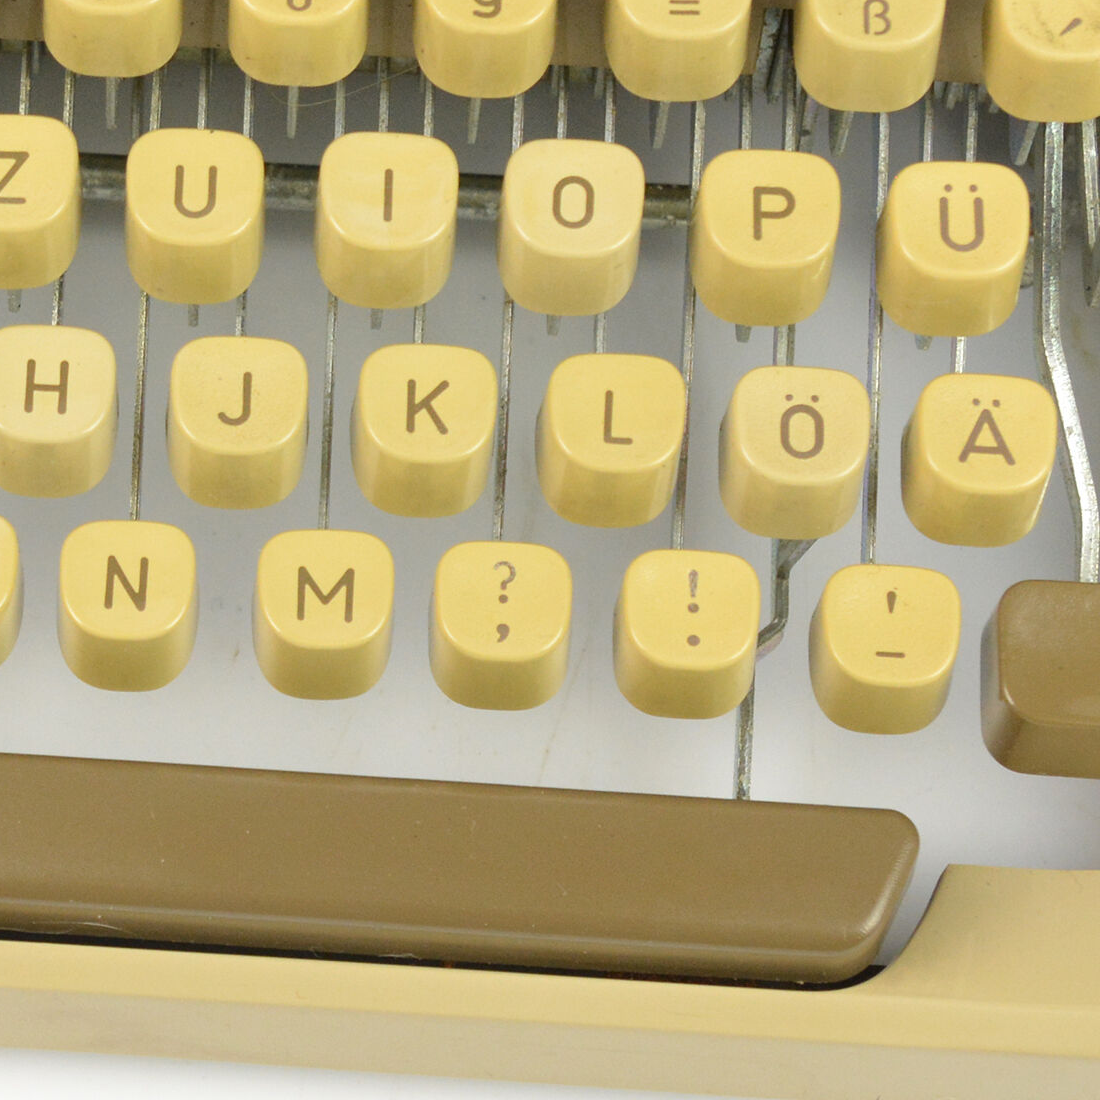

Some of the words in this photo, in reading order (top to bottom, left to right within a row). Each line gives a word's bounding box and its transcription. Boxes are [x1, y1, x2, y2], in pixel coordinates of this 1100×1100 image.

[173, 164, 218, 219] U
[383, 168, 394, 223] I
[551, 175, 595, 230] O
[752, 185, 796, 242] P
[938, 183, 985, 253] Ü
[23, 358, 70, 415] H
[217, 371, 253, 427] J
[405, 378, 450, 436] K
[603, 389, 634, 446] L
[779, 393, 825, 460] Ö
[957, 398, 1016, 466] Ä
[103, 554, 150, 612] N
[296, 565, 356, 624] M
[494, 560, 517, 605] ?
[687, 569, 700, 614] !
